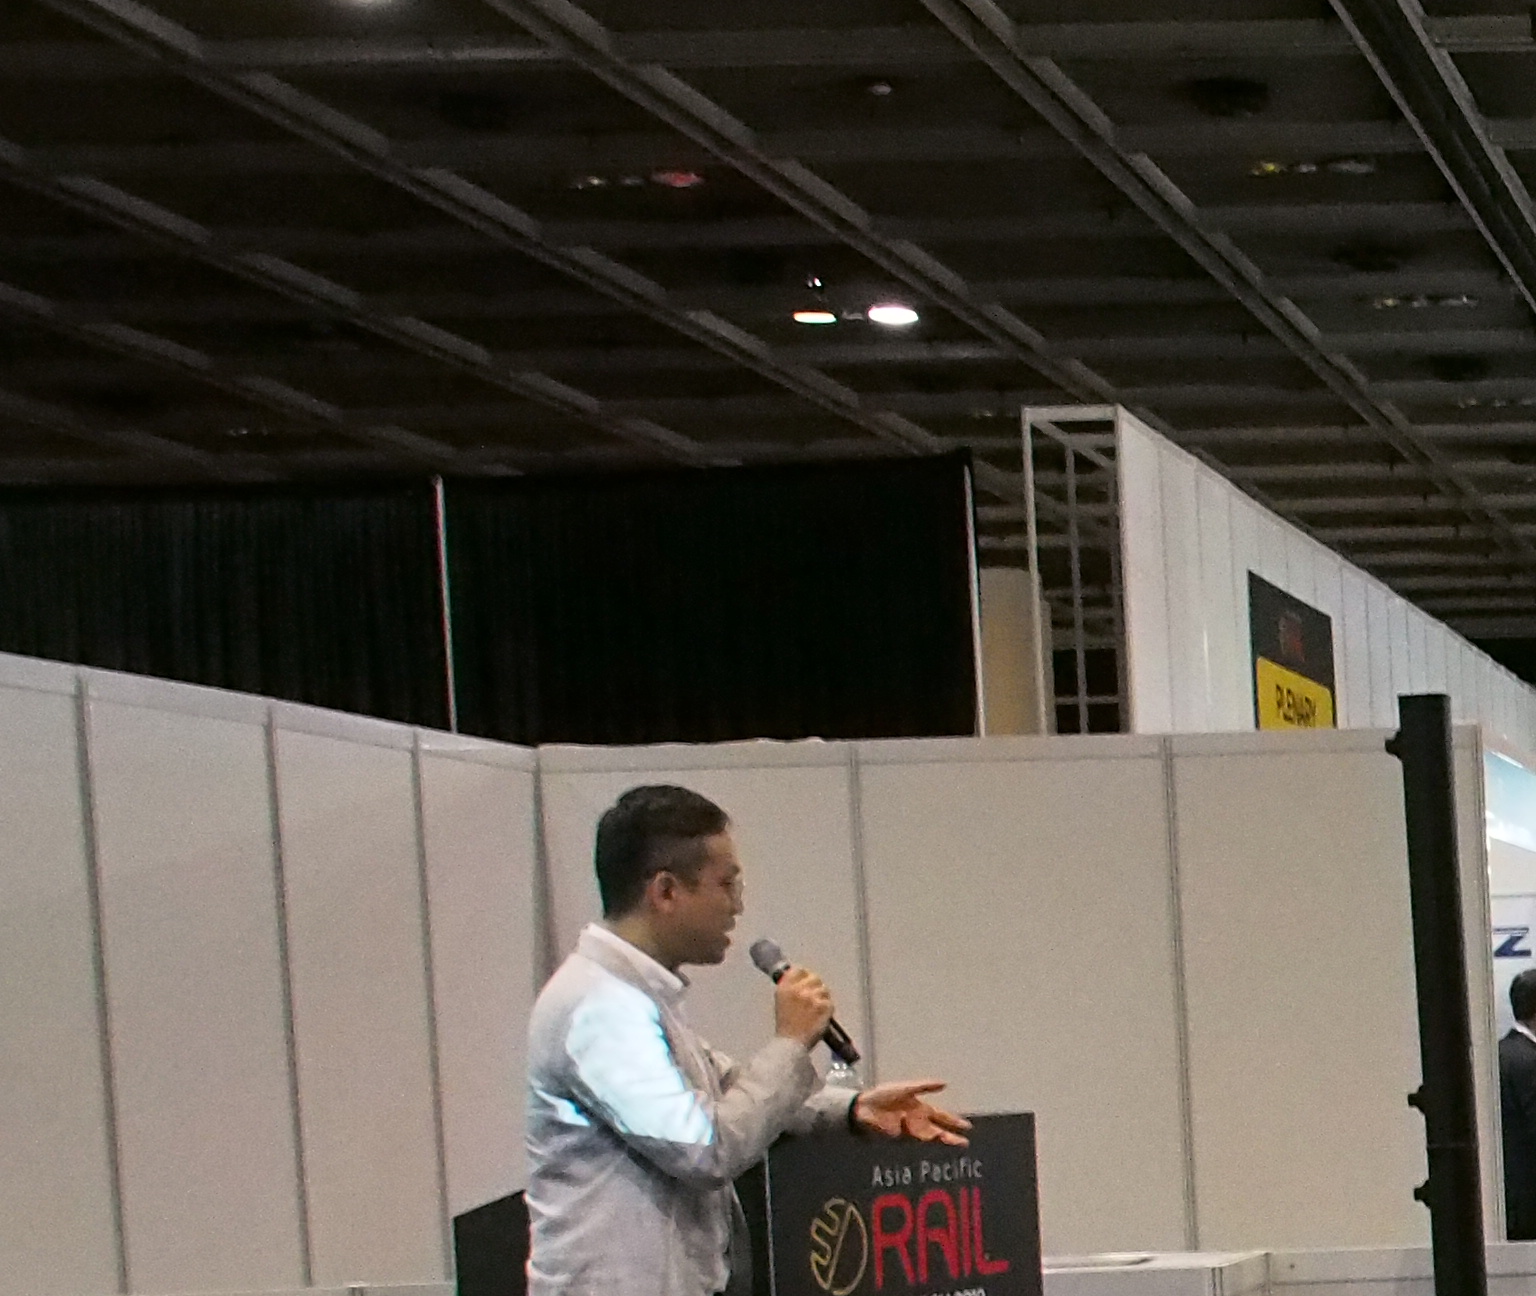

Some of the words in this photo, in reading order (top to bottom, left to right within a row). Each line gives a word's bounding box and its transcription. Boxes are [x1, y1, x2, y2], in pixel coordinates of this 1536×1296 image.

[871, 1164, 912, 1188] Asia
[920, 1157, 984, 1183] Pacific
[871, 1186, 1010, 1290] RAIL
